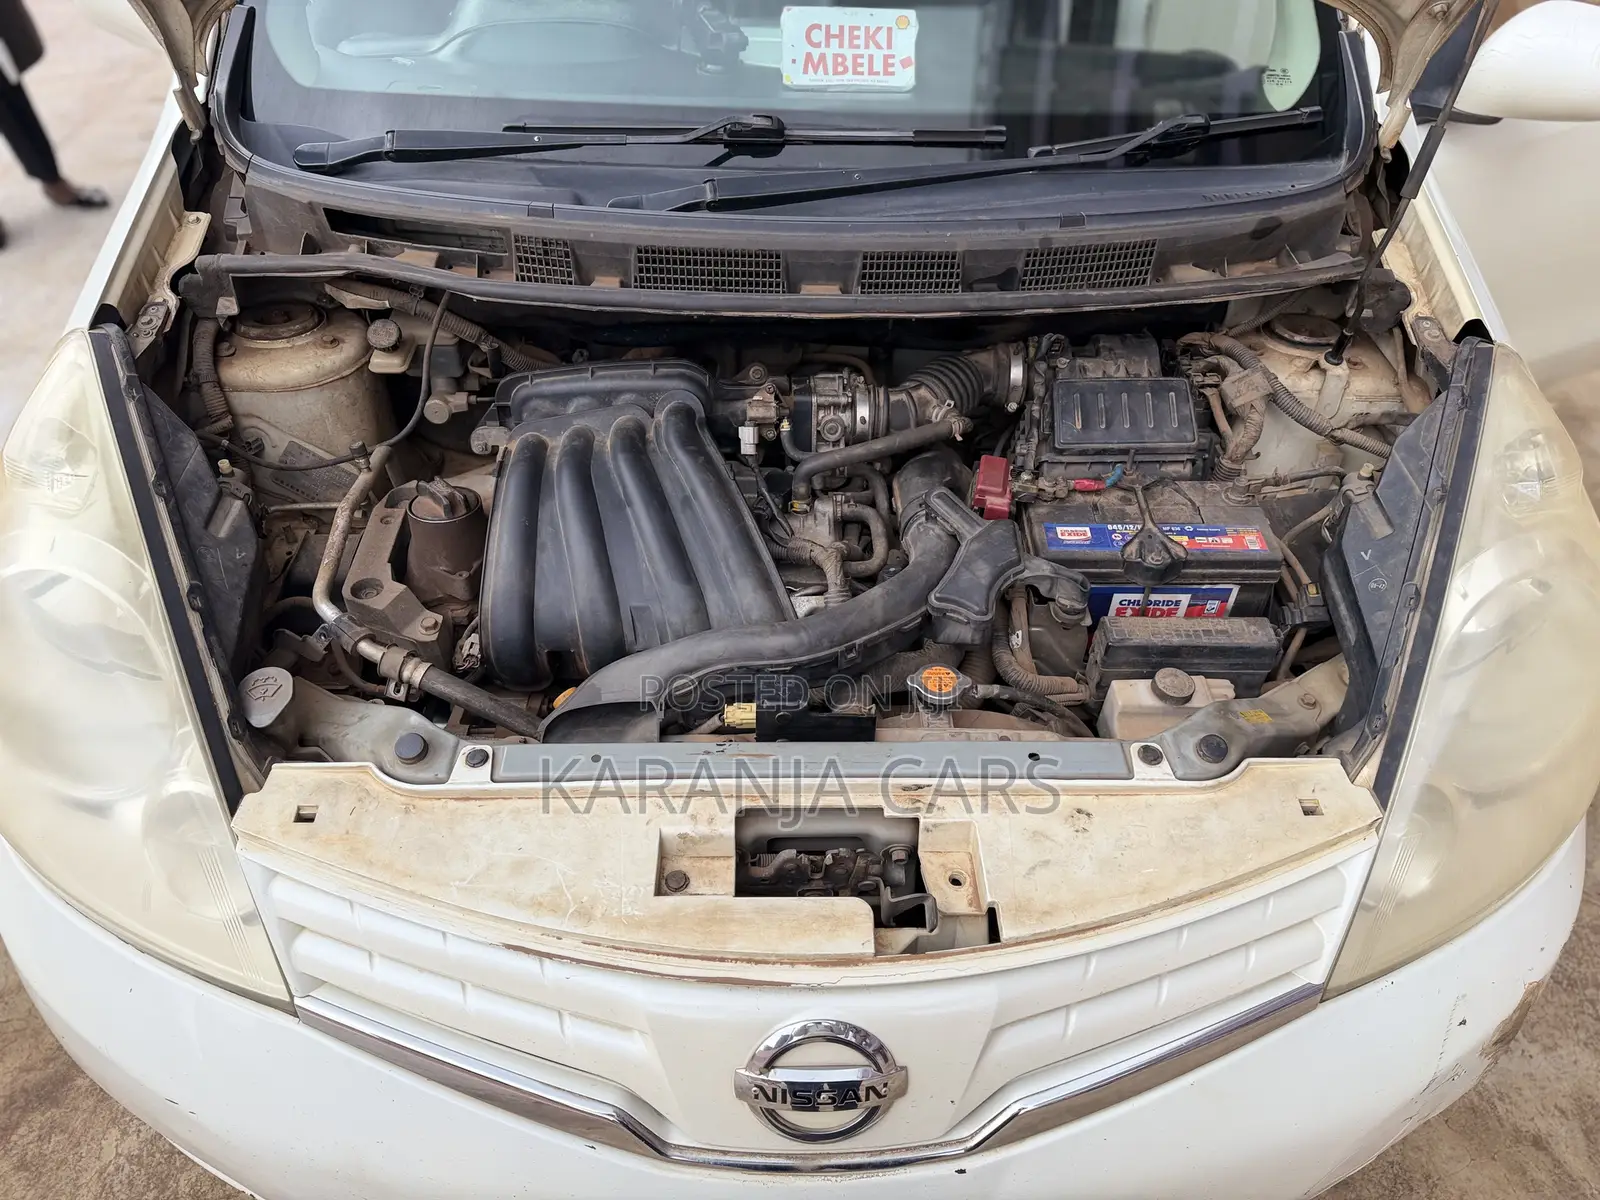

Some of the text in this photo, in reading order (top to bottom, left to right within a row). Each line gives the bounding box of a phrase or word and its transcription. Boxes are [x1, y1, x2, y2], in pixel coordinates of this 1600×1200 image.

[804, 23, 893, 50] CHEKI
[802, 51, 896, 76] MBELE
[752, 1082, 889, 1108] NISSAN
